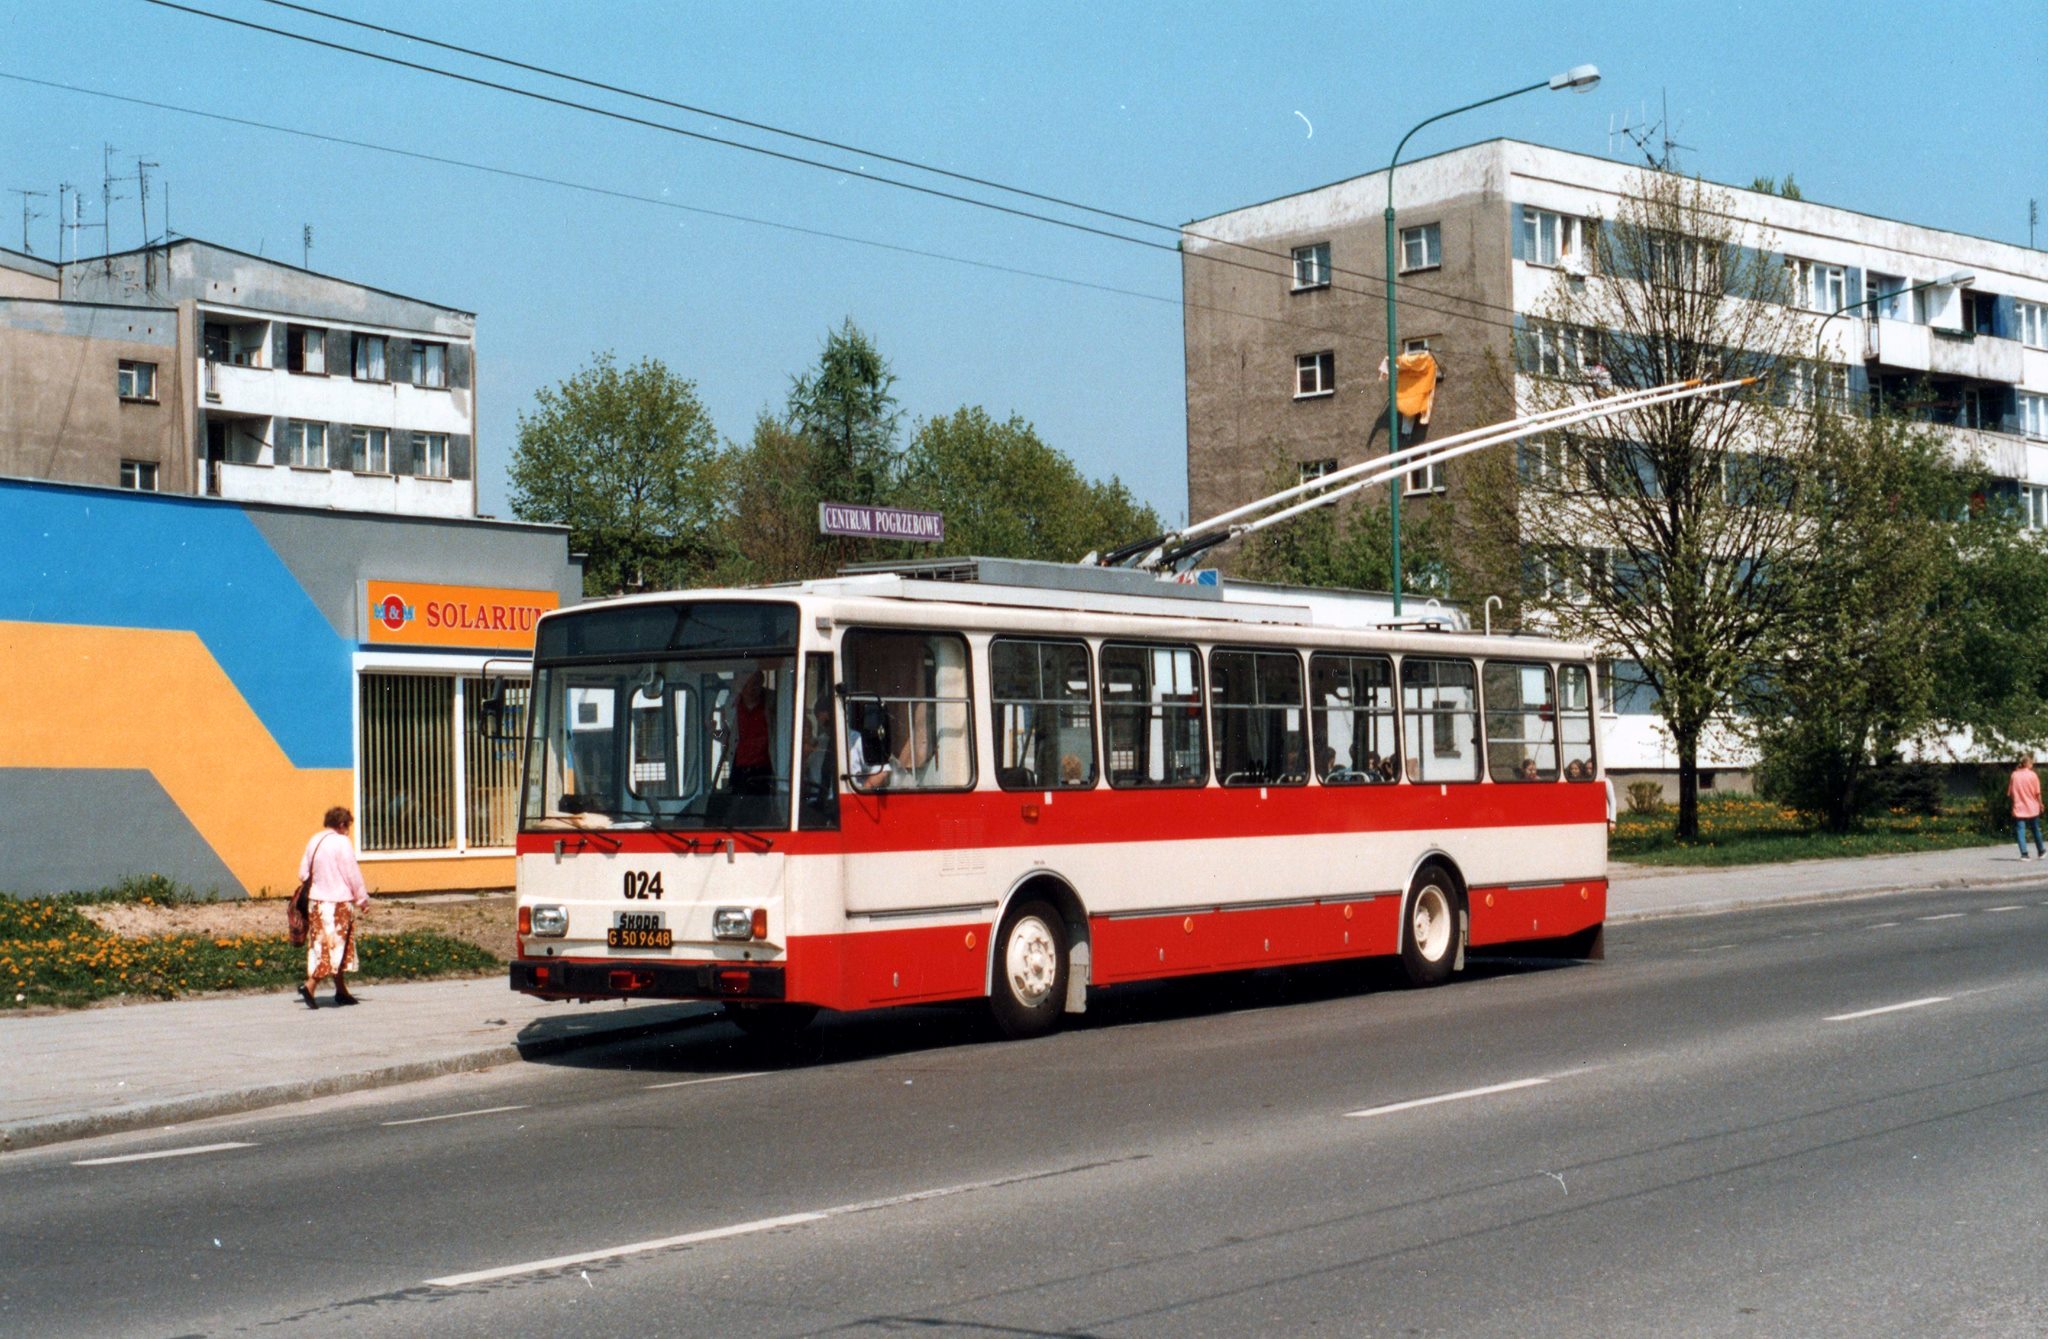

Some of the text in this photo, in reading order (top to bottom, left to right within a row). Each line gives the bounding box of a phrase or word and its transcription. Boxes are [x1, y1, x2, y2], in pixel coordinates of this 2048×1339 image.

[825, 507, 940, 536] CENTRUM POGRZEBOWE
[623, 870, 664, 899] 024
[619, 912, 660, 930] ŠKODA
[608, 931, 617, 946] G
